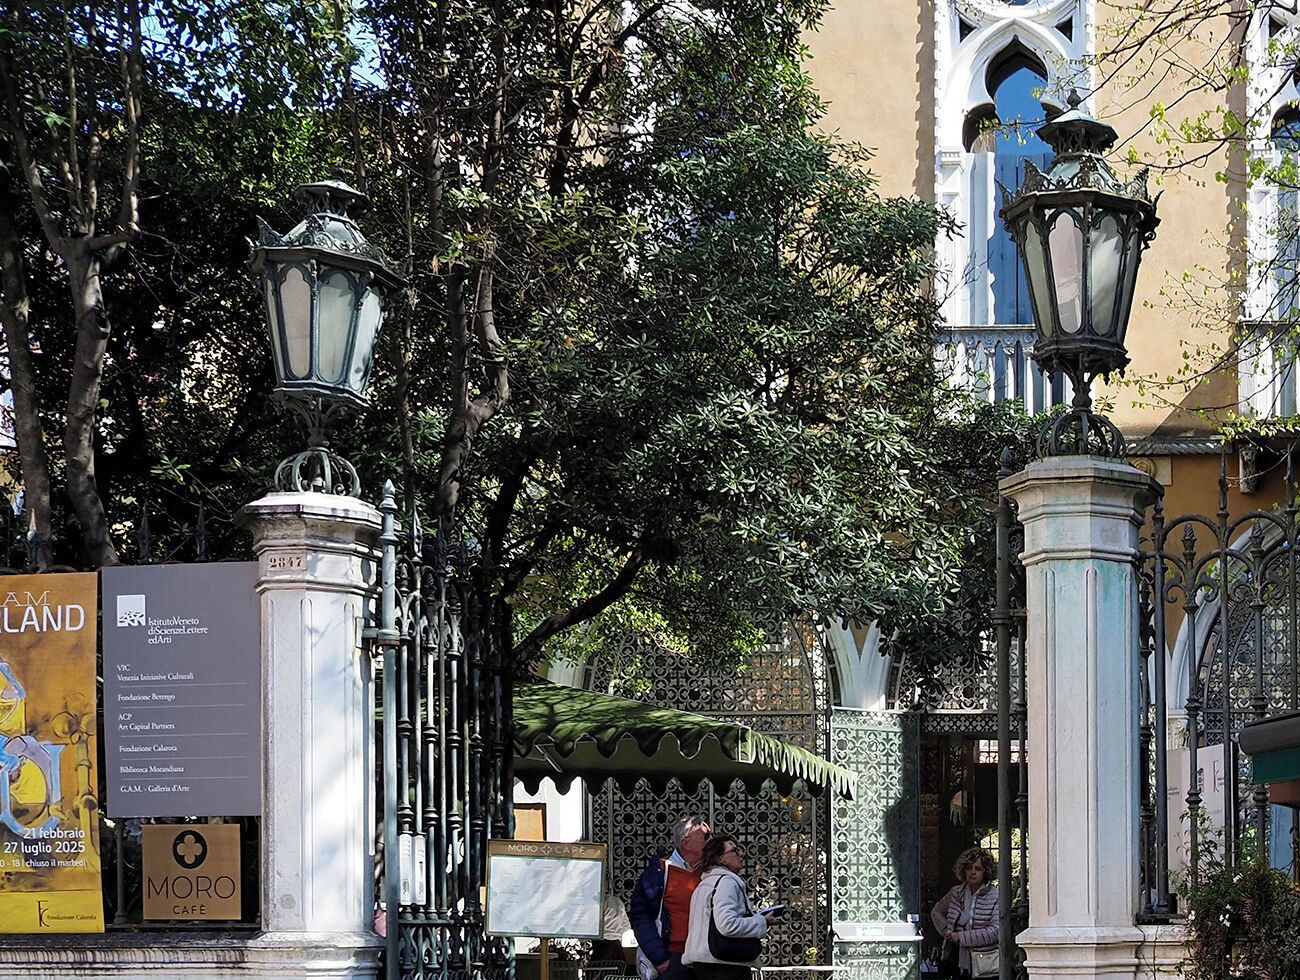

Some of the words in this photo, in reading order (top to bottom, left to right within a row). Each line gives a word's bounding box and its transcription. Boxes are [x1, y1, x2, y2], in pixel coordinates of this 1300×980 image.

[270, 557, 302, 568] 2847
[0, 604, 85, 633] LAND
[168, 672, 194, 680] Culturali
[152, 693, 176, 702] Berengo
[129, 722, 150, 732] Capital
[23, 828, 36, 839] 21
[40, 827, 85, 839] febbraio
[4, 842, 18, 854] 27
[21, 841, 52, 856] luglio
[55, 841, 86, 853] 2025
[508, 844, 537, 852] MORO
[25, 859, 50, 868] chiuso
[51, 859, 56, 867] il
[147, 876, 236, 899] MORO
